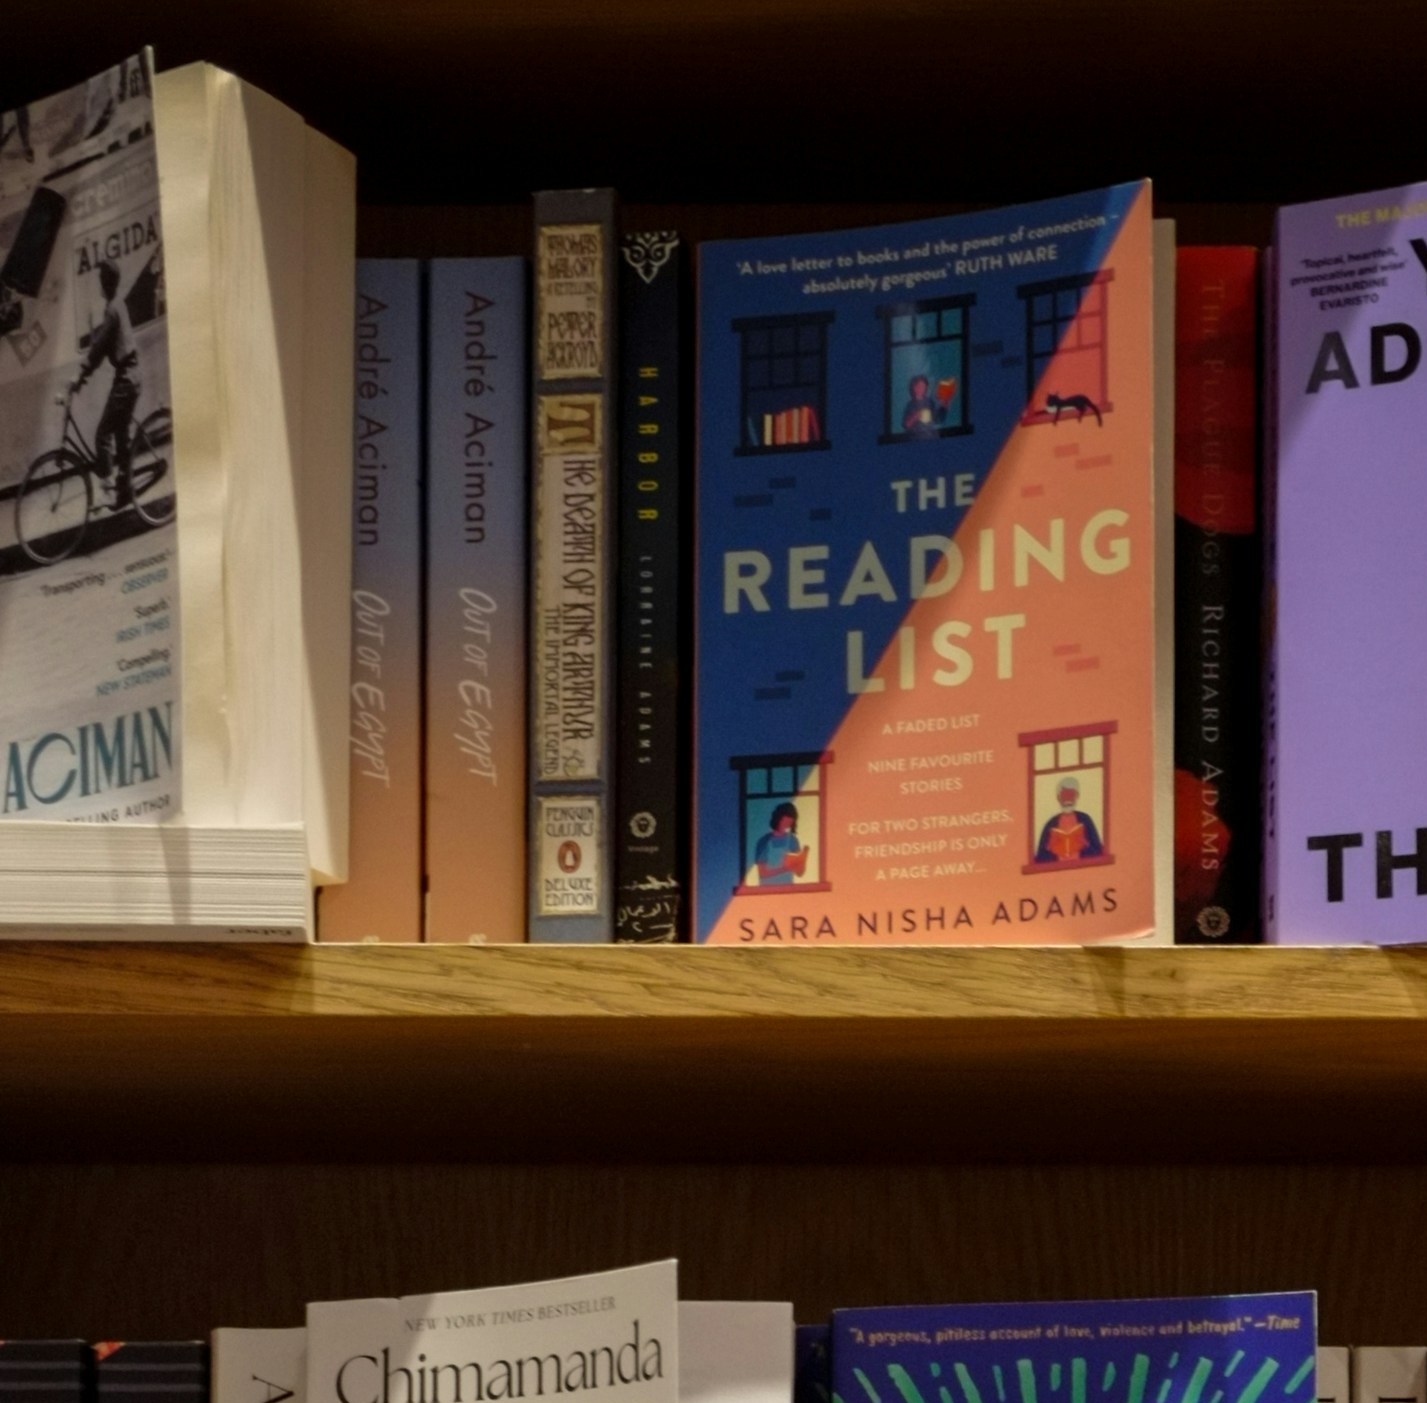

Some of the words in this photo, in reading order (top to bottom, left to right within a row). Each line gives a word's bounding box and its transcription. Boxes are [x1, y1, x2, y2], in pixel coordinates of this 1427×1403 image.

[77, 216, 158, 276] ALGIDA
[757, 259, 788, 276] love
[791, 256, 834, 274] letter
[838, 254, 854, 269] to
[857, 249, 900, 267] books
[904, 244, 931, 263] and
[935, 239, 960, 258] the
[963, 235, 1007, 258] power
[1009, 228, 1026, 246] of
[1028, 215, 1106, 242] connection
[803, 274, 881, 296] absolutely
[956, 253, 1003, 278] RUTH
[1010, 245, 1059, 269] WARE
[465, 291, 498, 399] André
[465, 414, 496, 546] Aciman
[639, 366, 660, 522] HARBOR
[891, 475, 977, 513] THE
[723, 510, 1131, 615] READING
[847, 614, 1026, 694] LIST
[1201, 604, 1226, 744] RICHARD
[3, 702, 176, 814] ACIMAN
[1201, 763, 1226, 872] ADAMS
[740, 917, 837, 944] SARA
[857, 905, 974, 938] NISHA
[992, 888, 1118, 926] ADAMS
